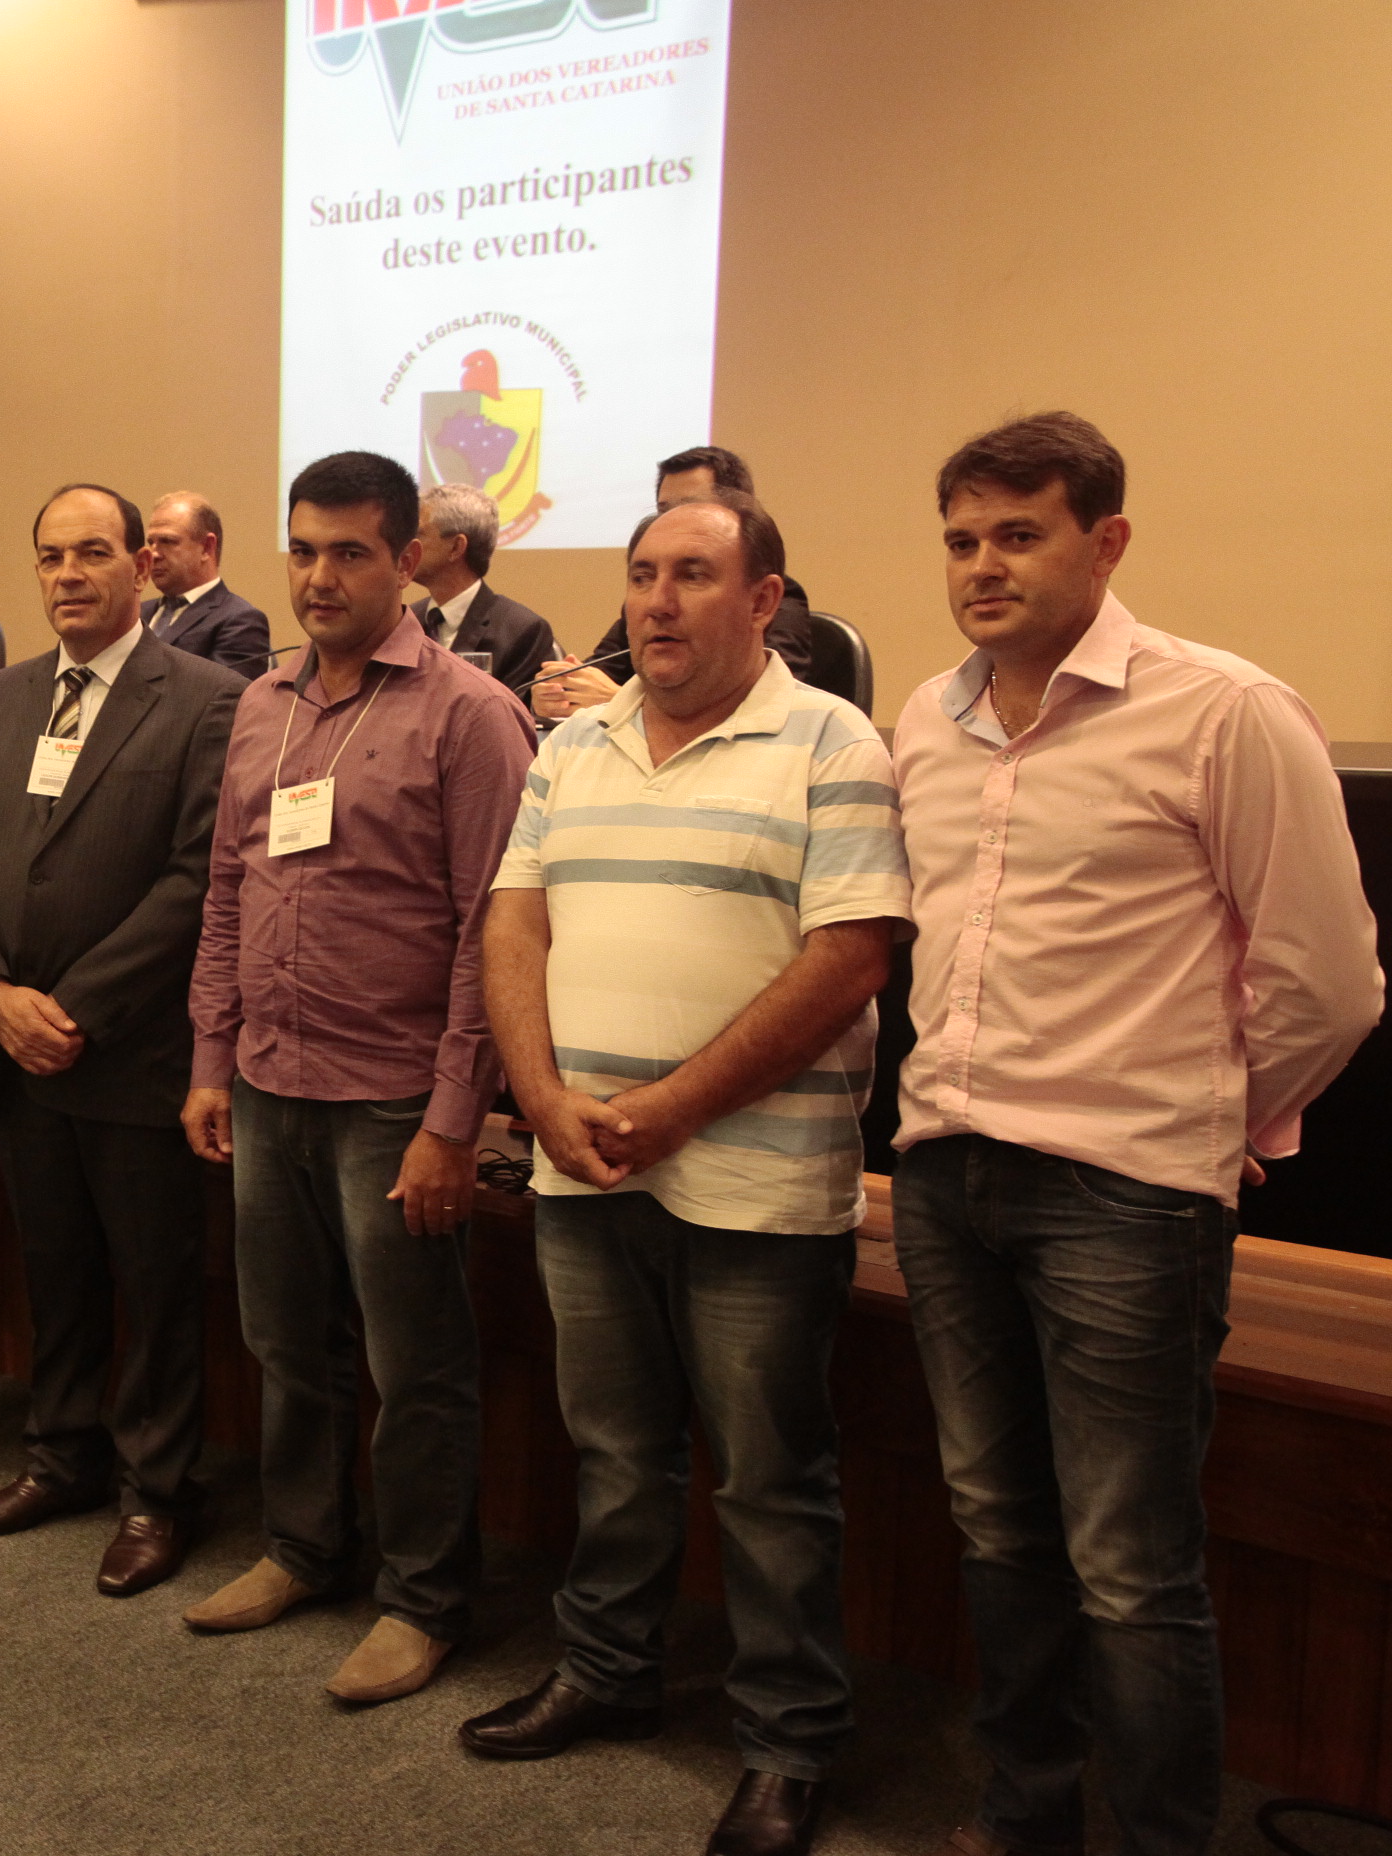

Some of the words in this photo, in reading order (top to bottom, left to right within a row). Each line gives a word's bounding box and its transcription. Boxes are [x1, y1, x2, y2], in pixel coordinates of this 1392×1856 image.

[437, 75, 503, 100] UNIÃO
[504, 67, 552, 93] DOS
[558, 37, 711, 78] VEREADORES
[454, 102, 484, 120] DE
[485, 91, 556, 115] SANTA
[561, 70, 677, 103] CATARINA
[309, 189, 402, 227] Saúda
[413, 188, 445, 216] os
[456, 155, 695, 220] participantes
[382, 237, 462, 271] deste
[473, 222, 597, 262] evento.
[379, 350, 417, 406] PODER
[416, 311, 522, 352] LEGISLATIVO
[524, 320, 590, 402] MUNICIPAL
